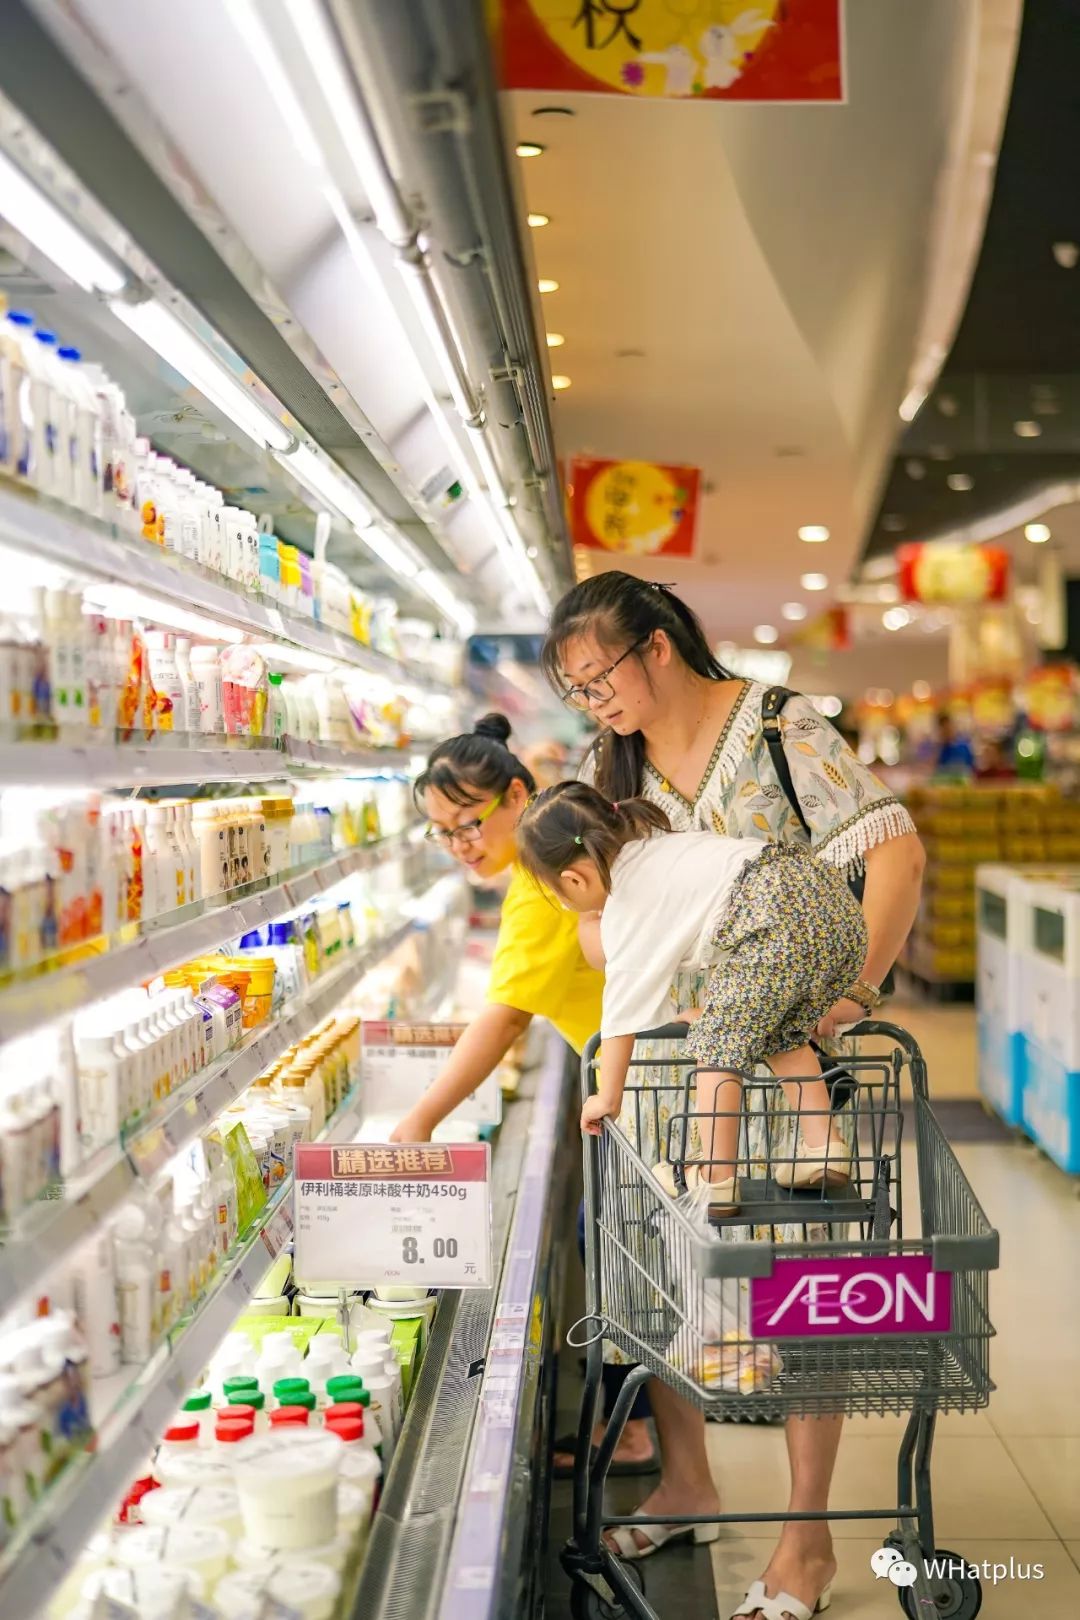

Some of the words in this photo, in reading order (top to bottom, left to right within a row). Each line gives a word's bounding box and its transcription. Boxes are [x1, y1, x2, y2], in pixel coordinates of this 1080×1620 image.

[336, 1148, 448, 1175] 精选推荐
[300, 1182, 468, 1201] 伊利桶装原味酸牛奶450g
[463, 1262, 477, 1275] 元
